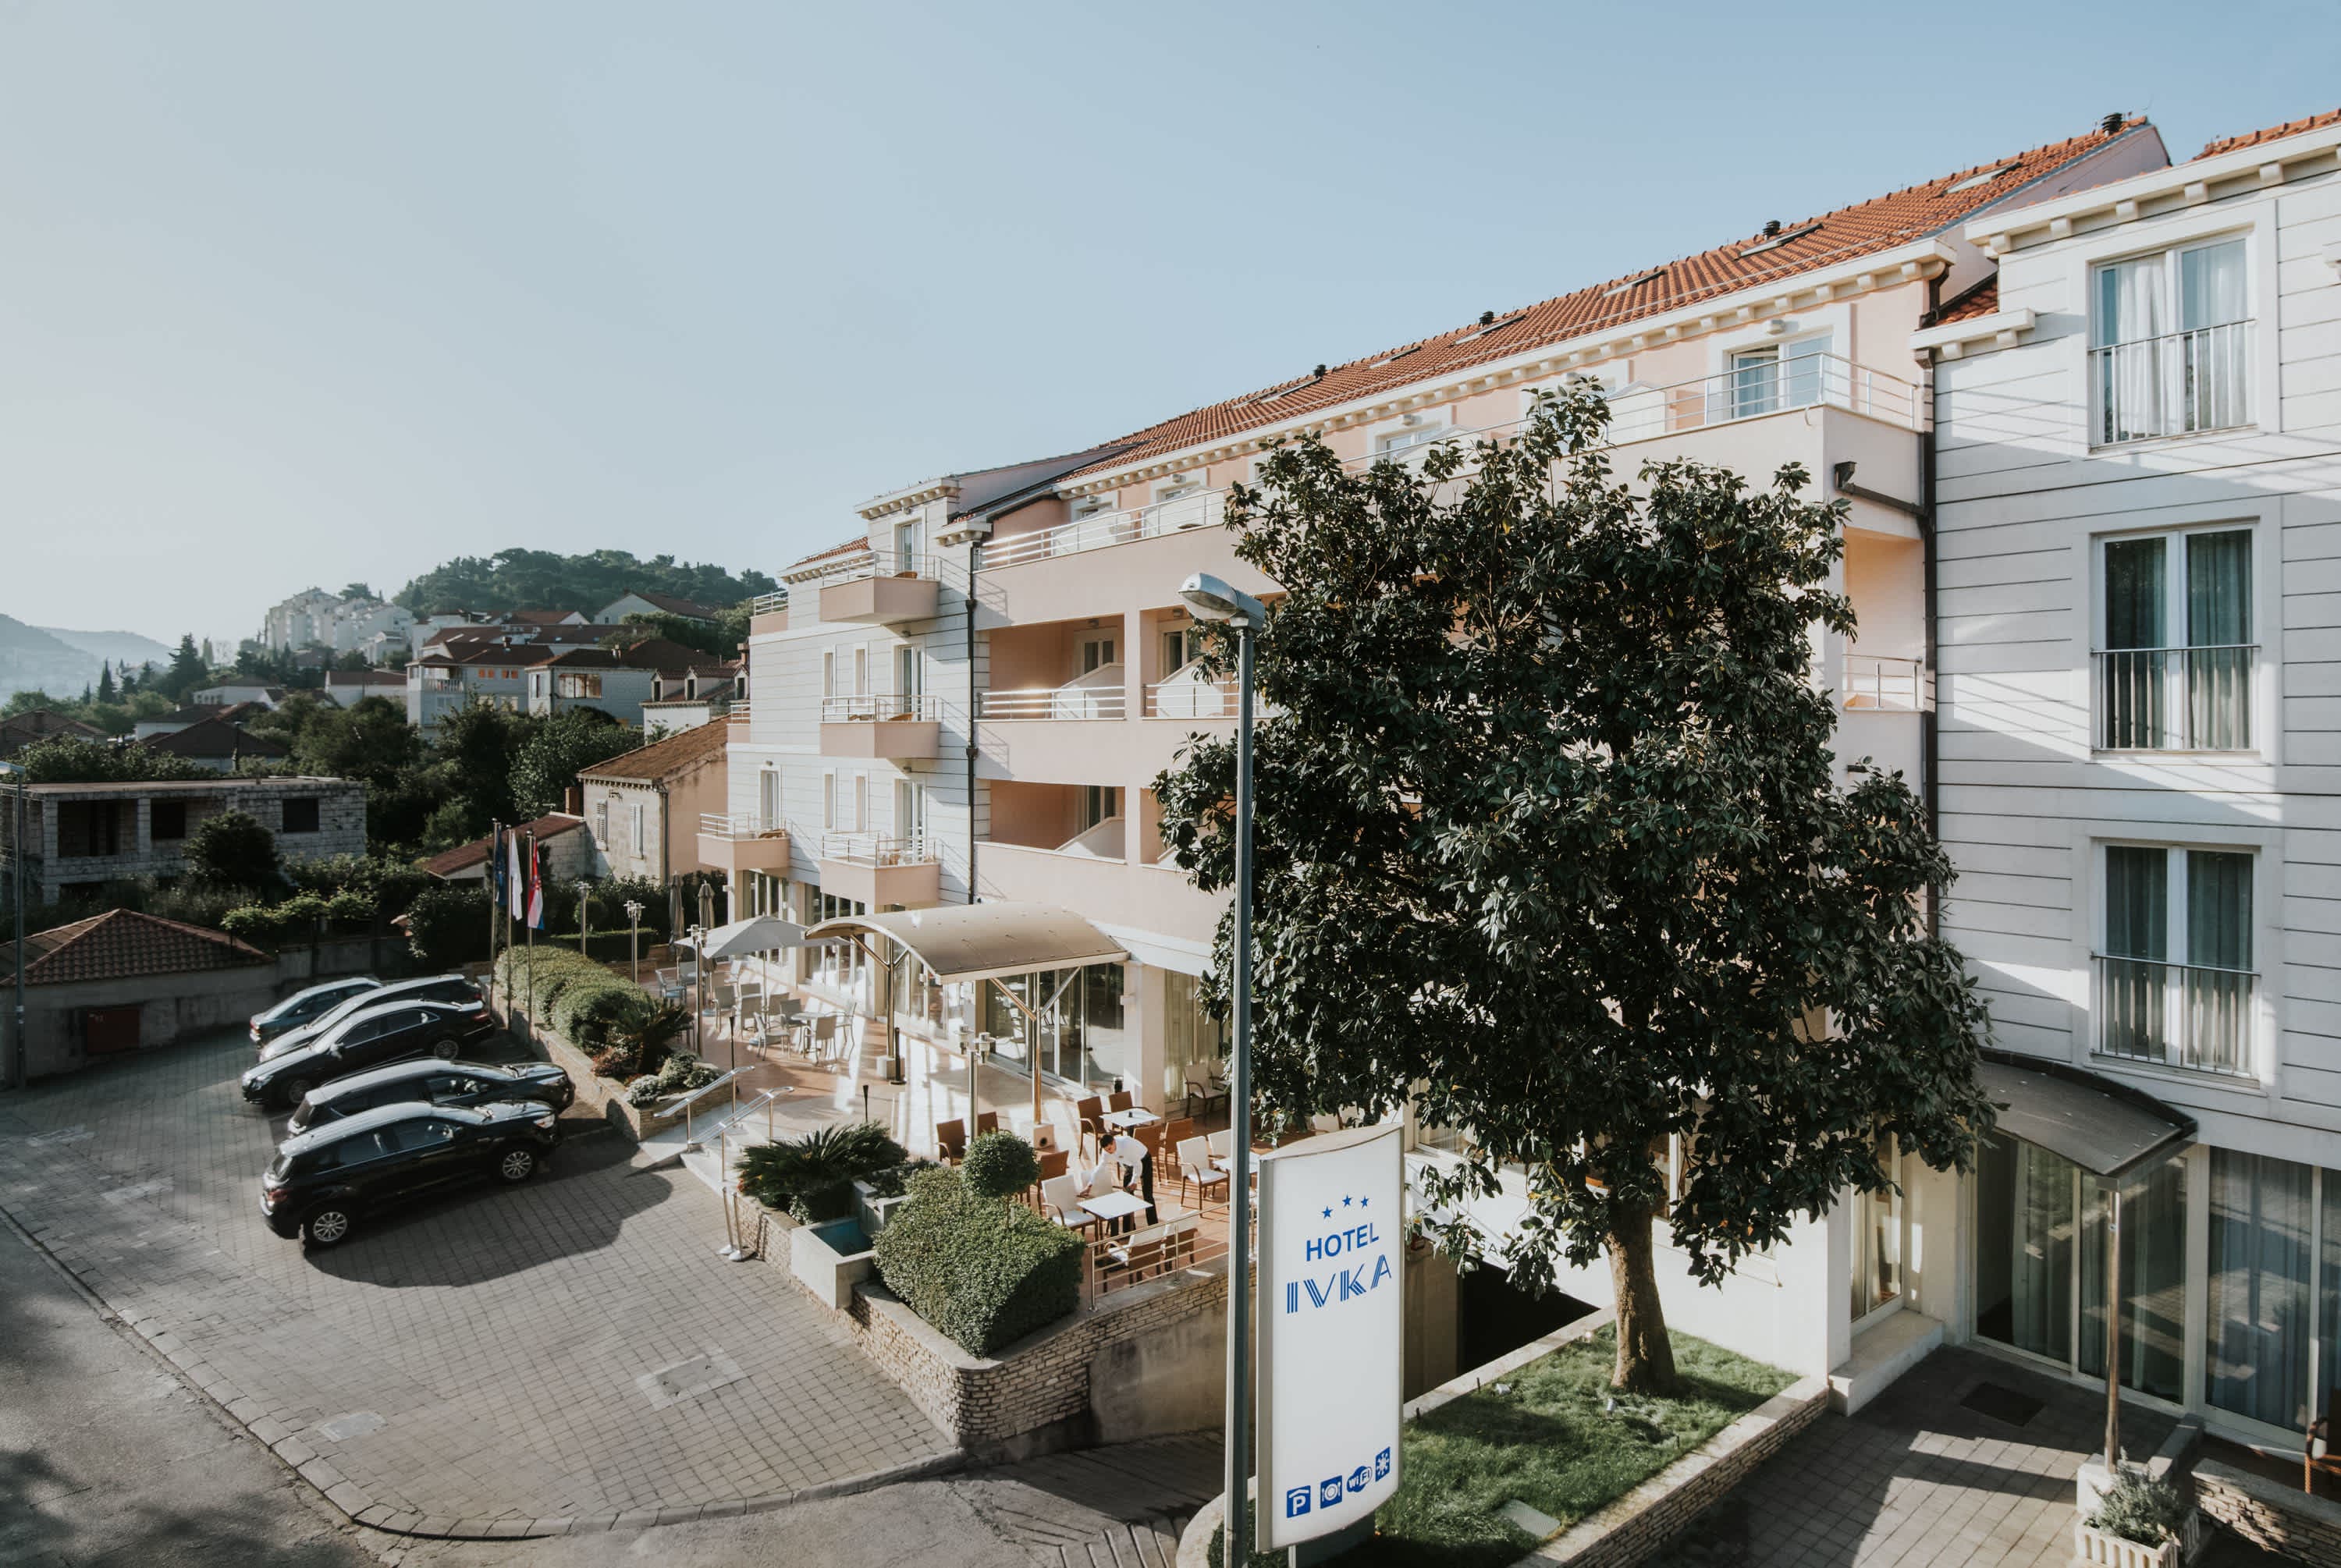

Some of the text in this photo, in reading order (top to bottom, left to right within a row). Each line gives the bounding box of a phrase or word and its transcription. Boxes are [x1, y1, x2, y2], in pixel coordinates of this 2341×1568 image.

[1306, 1222, 1379, 1261] HOTEL
[1287, 1254, 1391, 1314] IVKA
[1293, 1495, 1306, 1515] P
